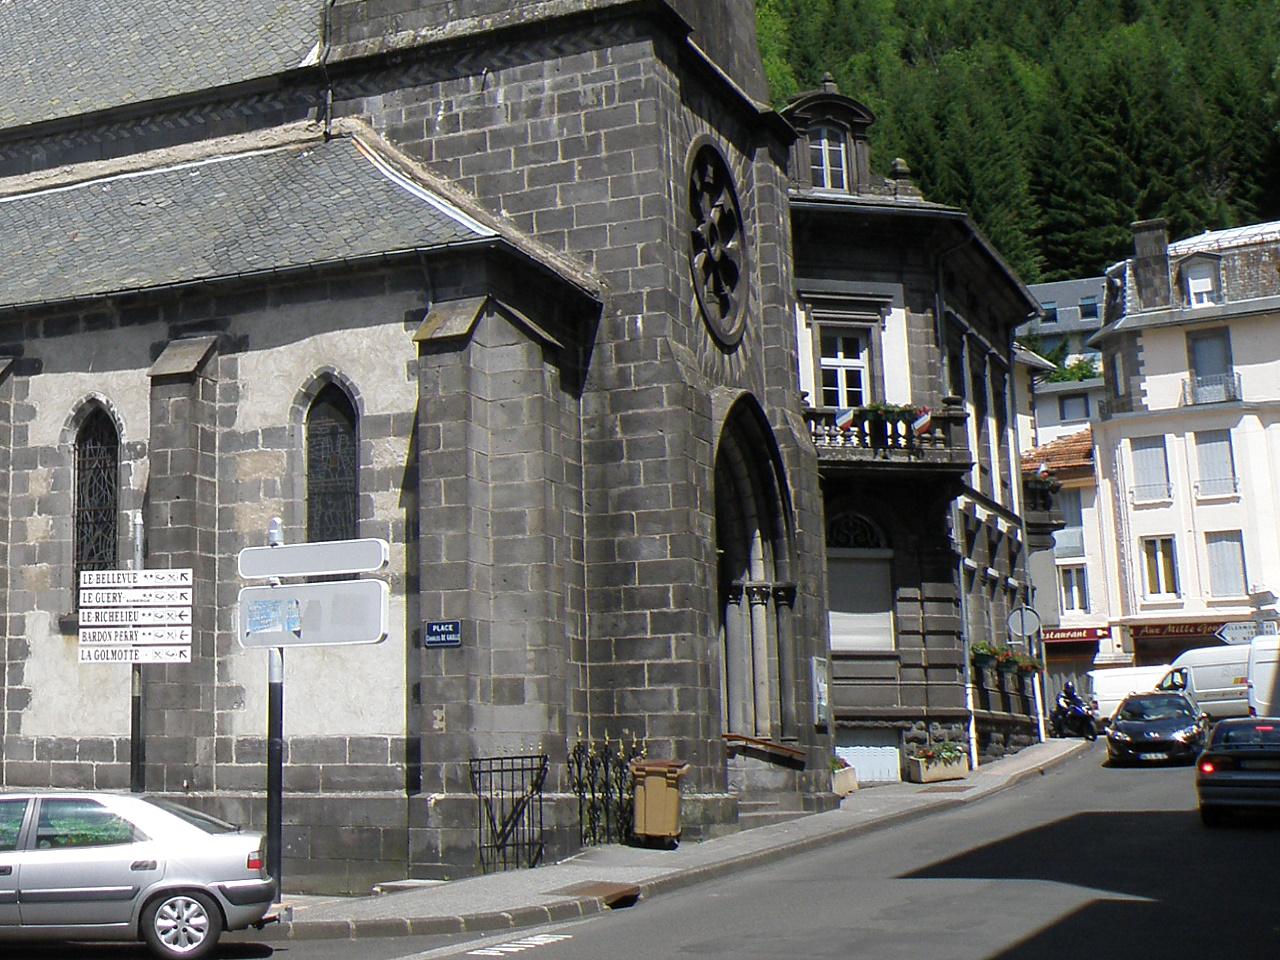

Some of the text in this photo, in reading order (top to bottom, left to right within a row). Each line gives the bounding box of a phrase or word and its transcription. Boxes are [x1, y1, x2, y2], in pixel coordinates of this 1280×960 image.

[83, 573, 138, 584] LE BELLEVUE
[83, 593, 93, 603] LE
[82, 611, 139, 622] LE RICHELIEU
[432, 624, 454, 632] PLACE
[81, 649, 140, 660] LA GOLMOTTE
